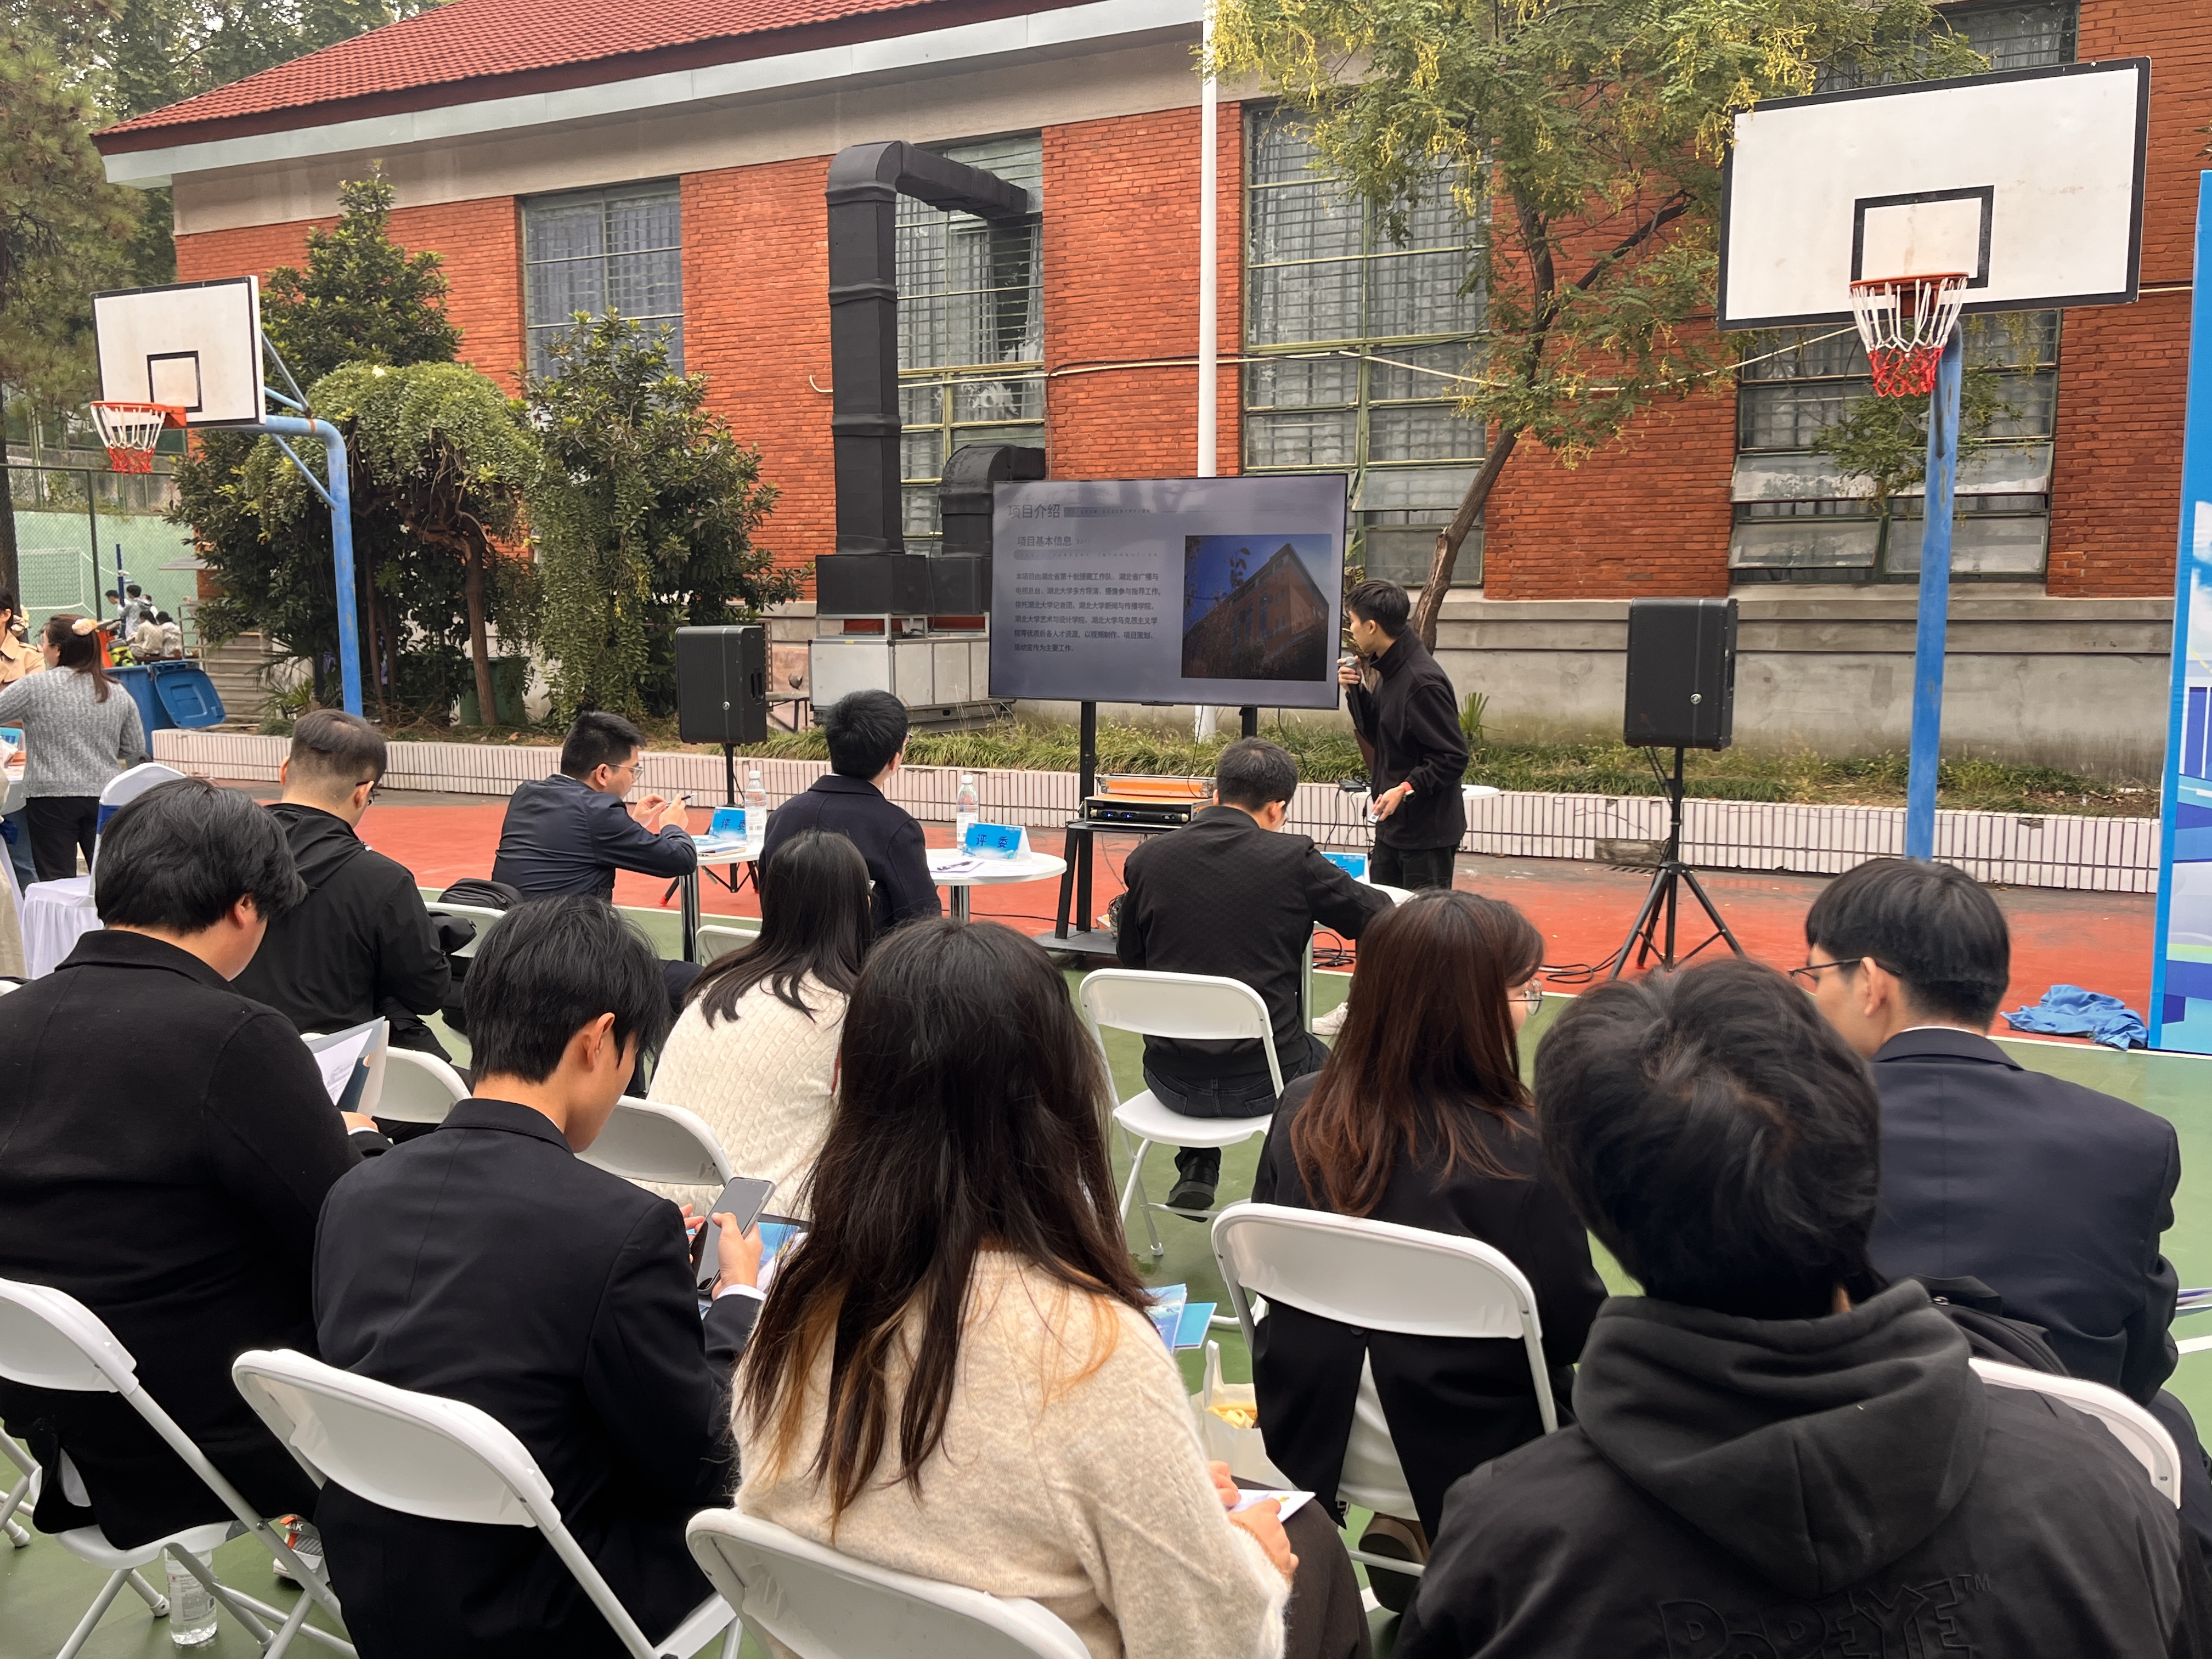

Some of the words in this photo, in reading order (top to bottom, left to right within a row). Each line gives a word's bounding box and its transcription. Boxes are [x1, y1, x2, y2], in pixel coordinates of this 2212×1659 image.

[1008, 504, 1060, 519] 项目介绍
[1017, 535, 1072, 547] 项目基本信息
[976, 834, 1008, 849] 评委
